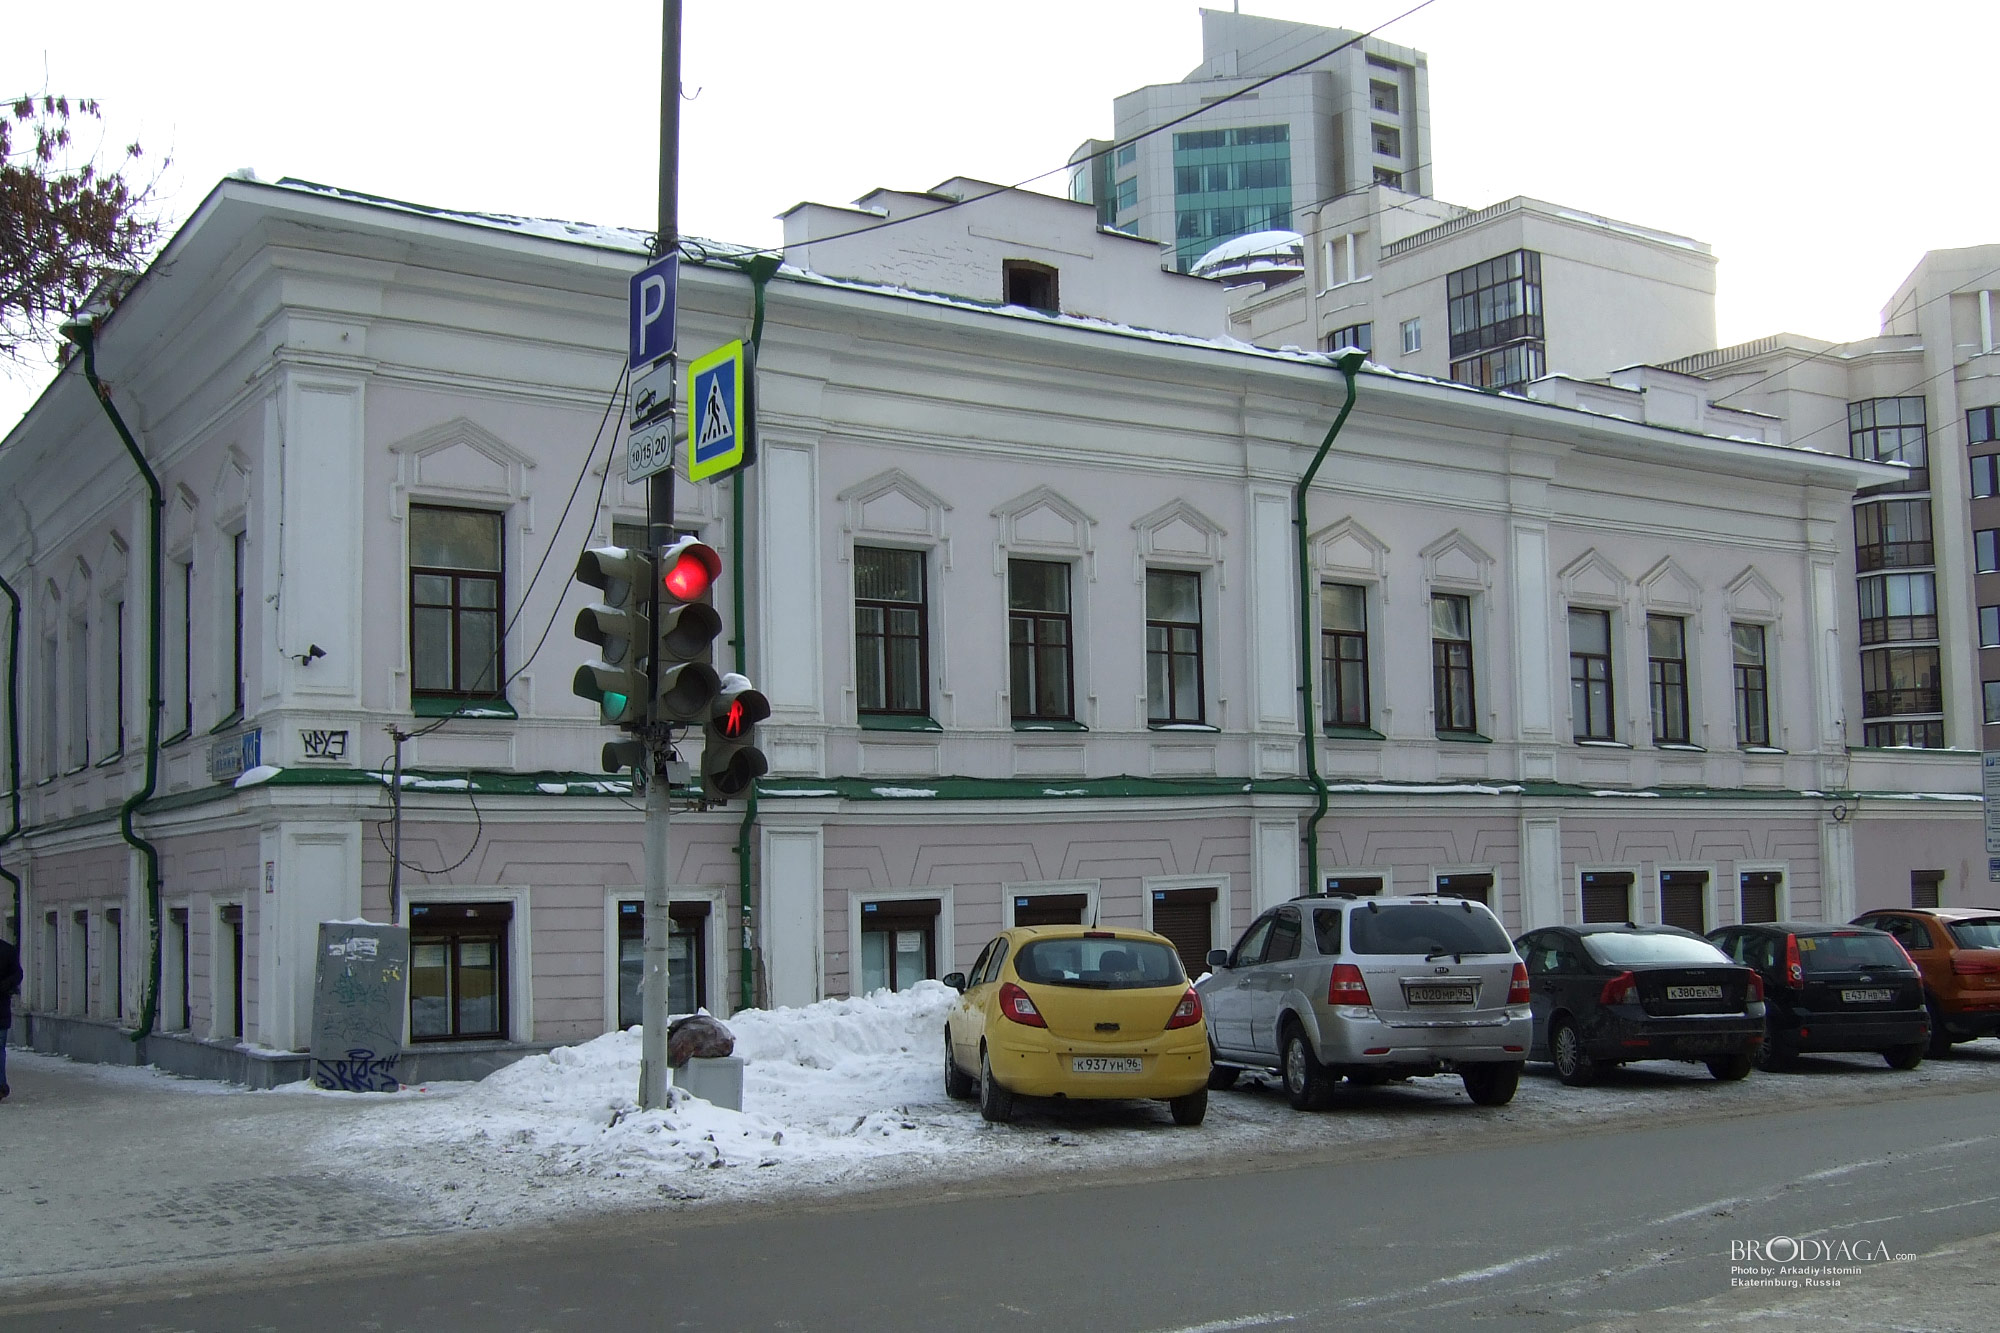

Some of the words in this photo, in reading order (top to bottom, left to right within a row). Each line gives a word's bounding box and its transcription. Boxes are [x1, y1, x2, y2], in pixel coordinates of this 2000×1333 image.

[639, 274, 666, 356] P
[632, 450, 640, 463] 10
[643, 443, 651, 460] 15
[655, 435, 667, 456] 20
